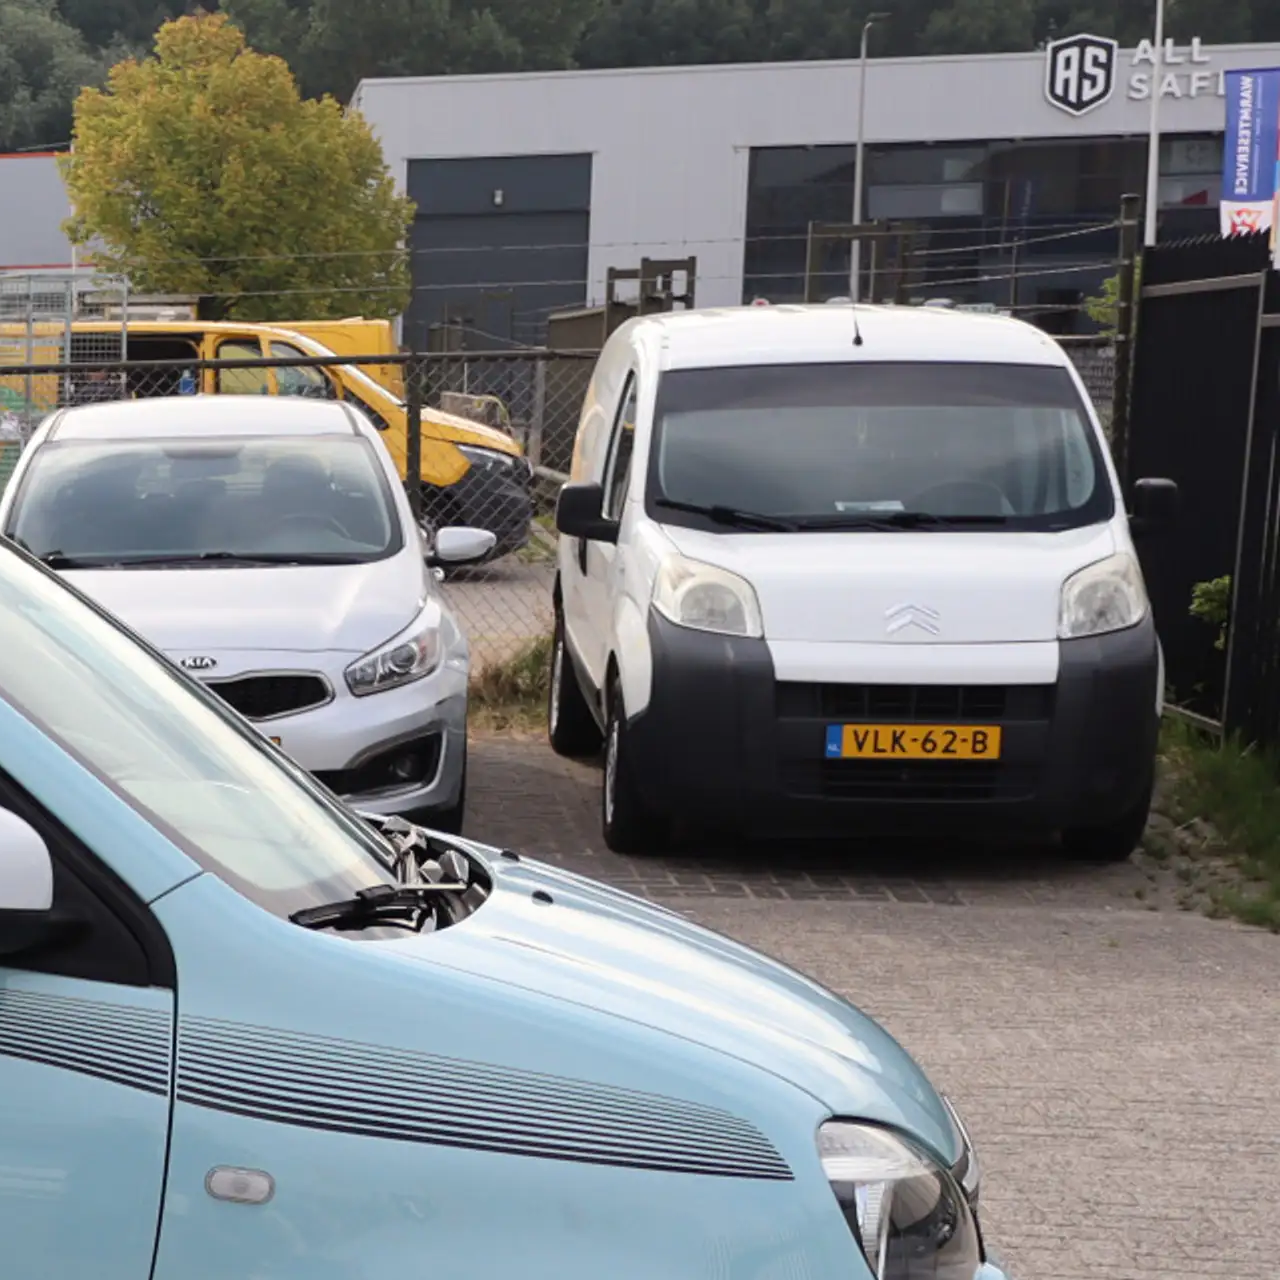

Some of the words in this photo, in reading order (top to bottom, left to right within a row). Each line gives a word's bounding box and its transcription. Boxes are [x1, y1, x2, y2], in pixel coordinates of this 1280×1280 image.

[1131, 37, 1211, 66] ALL
[1054, 46, 1107, 103] AS
[186, 657, 213, 666] KIA
[852, 729, 989, 754] VLK-62-B
